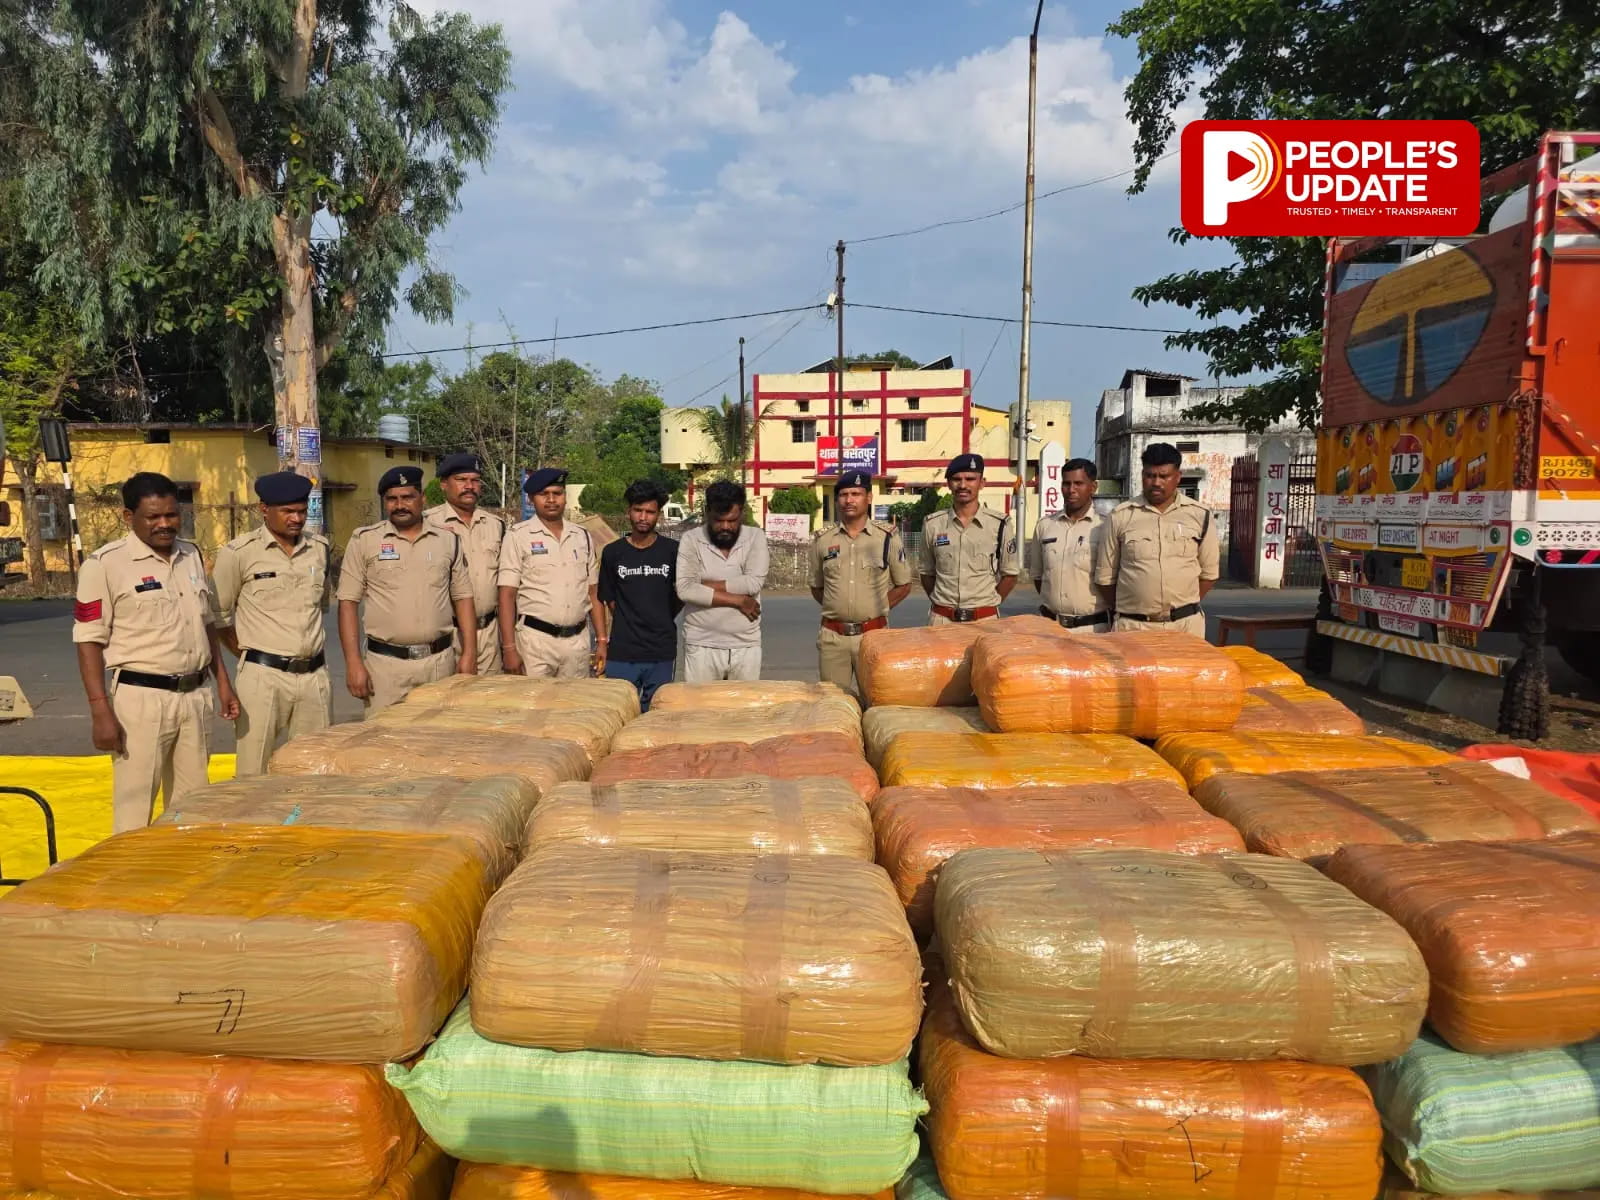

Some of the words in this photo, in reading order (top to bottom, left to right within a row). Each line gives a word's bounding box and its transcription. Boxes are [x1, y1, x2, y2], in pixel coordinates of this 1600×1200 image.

[842, 445, 876, 463] बसंतपुर
[1542, 468, 1591, 477] 9078
[1429, 531, 1438, 541] AT
[1439, 531, 1460, 544] NIGHT
